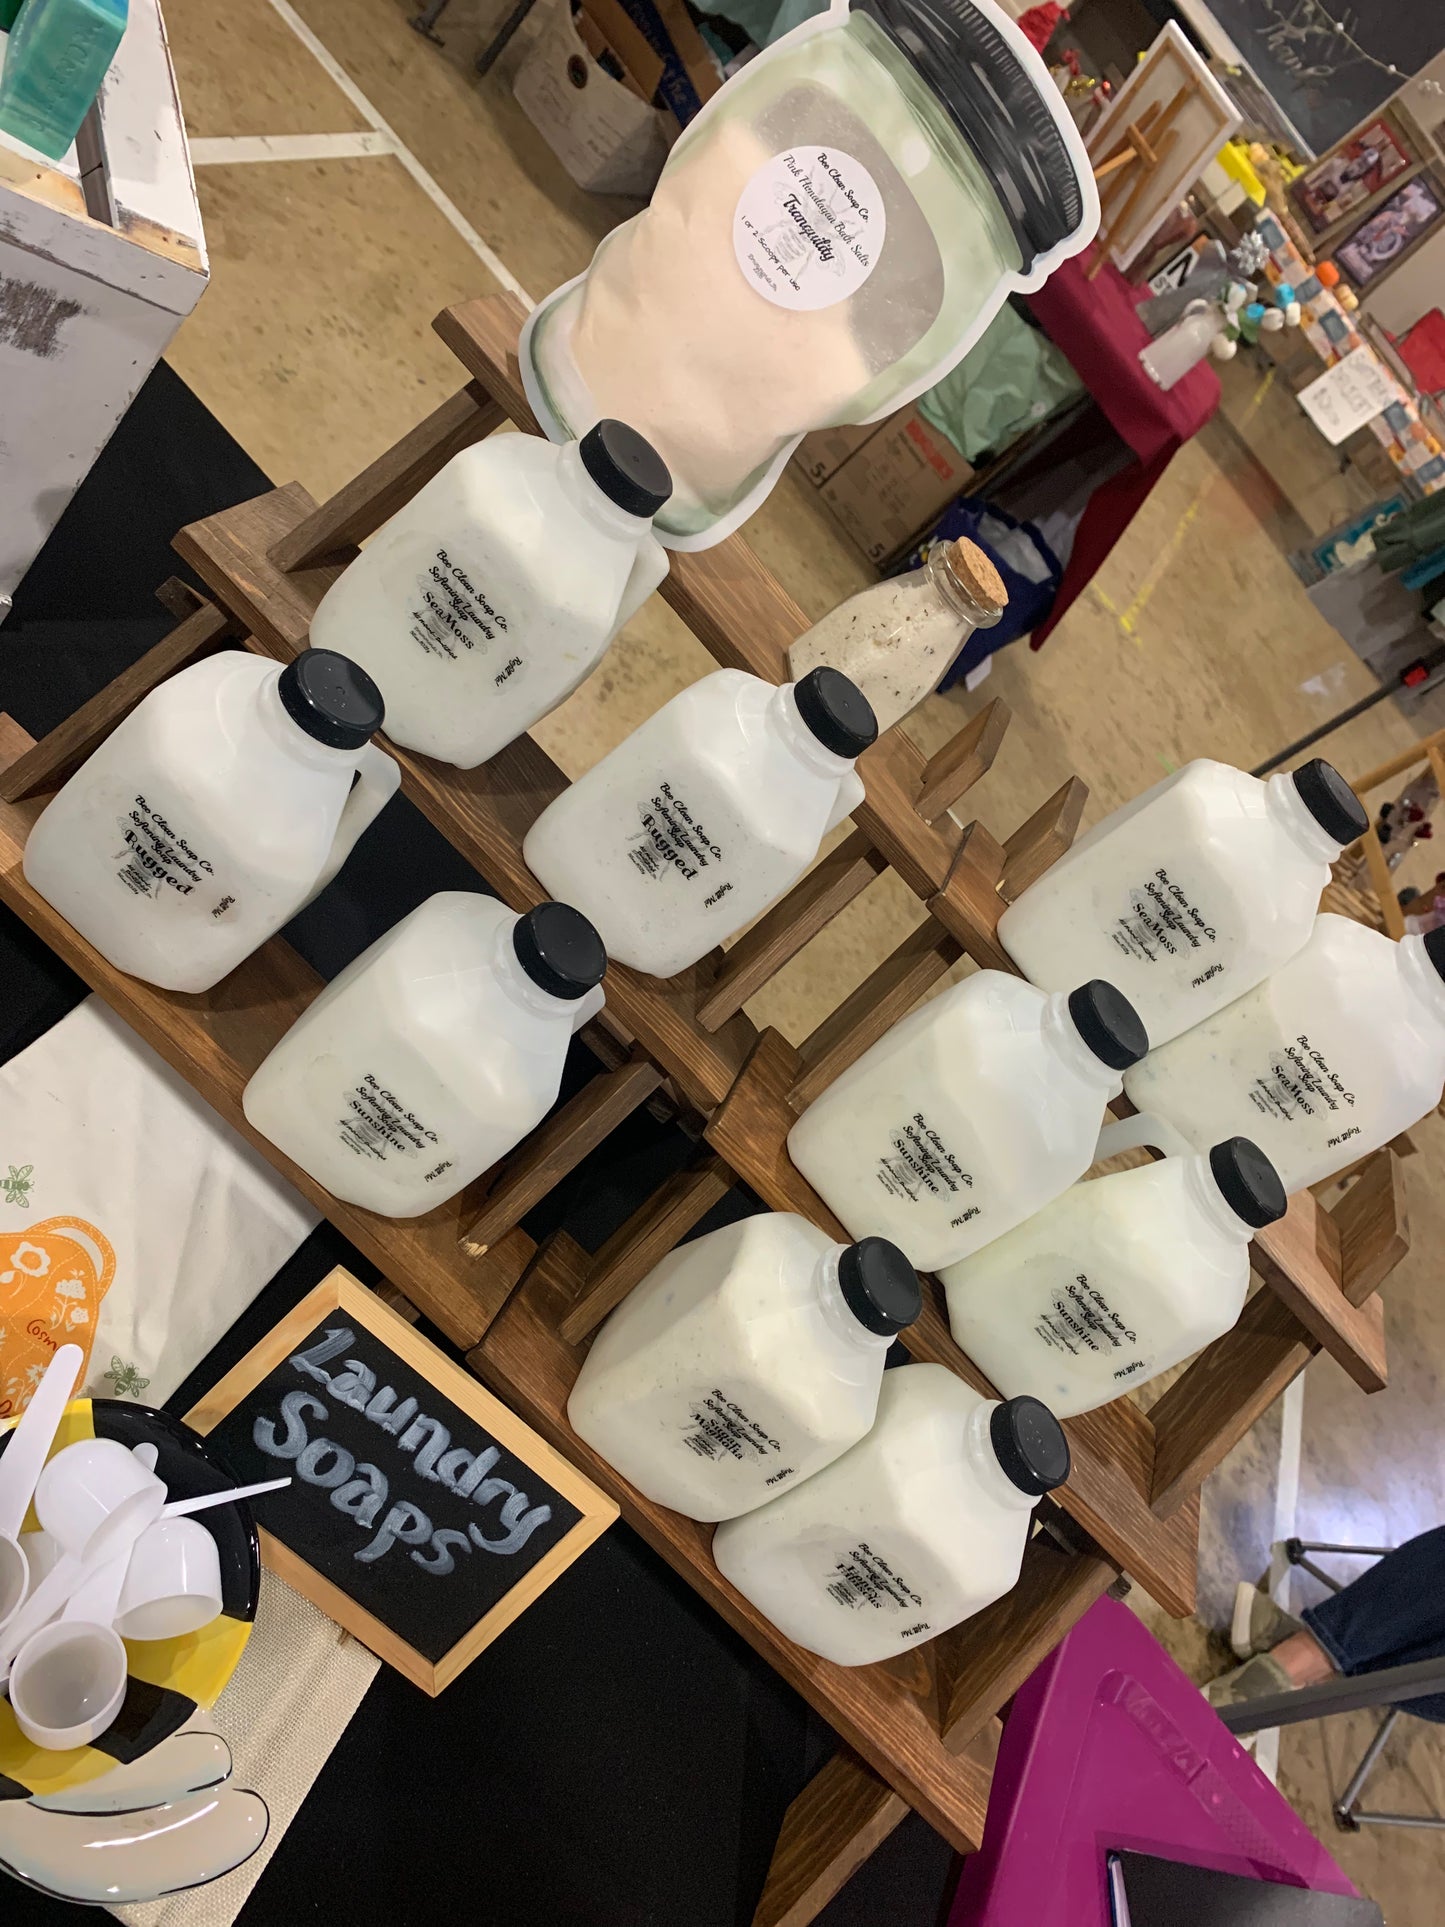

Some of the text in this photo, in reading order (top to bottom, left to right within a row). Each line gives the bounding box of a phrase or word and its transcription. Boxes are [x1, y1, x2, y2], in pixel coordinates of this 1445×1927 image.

[783, 154, 869, 266] Pink Himalayan Bath Salts
[817, 152, 869, 222] Bee Clean Soap Co.
[783, 193, 834, 261] Tranquility
[744, 220, 754, 229] or
[757, 237, 780, 264] Scoops
[776, 264, 790, 276] per
[789, 278, 800, 291] use
[810, 461, 826, 479] 5
[868, 542, 886, 559] 5
[428, 566, 495, 640] Softening Laundry
[436, 549, 507, 633] Bee Clean Soap Co.
[448, 599, 468, 621] Soap
[423, 592, 474, 649] SeaMoss
[504, 656, 523, 676] Refill
[129, 810, 166, 851] Softening
[163, 846, 202, 882] Laundry
[135, 794, 214, 876] Bee Clean Soap Co.
[642, 814, 698, 880] Rugged
[651, 797, 708, 866] Softening Laundry
[660, 782, 721, 862] Bee Clean Soap Co.
[667, 828, 685, 848] Soap
[125, 829, 193, 895] Rugged
[150, 844, 172, 864] Soap
[714, 882, 733, 900] Refill
[1144, 882, 1201, 947] Softening Laundry
[1155, 868, 1216, 943] Bee Clean Soap Co.
[1133, 903, 1177, 954] SeaMoss
[1159, 911, 1177, 930] Soap
[1204, 963, 1224, 980] Refill
[1271, 1065, 1314, 1115] SeaMoss
[1284, 1047, 1339, 1110] Softening Laundry
[1296, 1035, 1355, 1107] Bee Clean Soap Co.
[1298, 1074, 1315, 1092] Soap
[349, 1100, 405, 1150] Sunshine
[355, 1086, 392, 1123] Softening
[390, 1118, 425, 1149] Laundry
[364, 1074, 380, 1090] Bee
[380, 1090, 403, 1112] Clean
[403, 1113, 424, 1131] Soap
[377, 1114, 397, 1134] Soap
[903, 1125, 959, 1191] Softening Laundry
[913, 1113, 973, 1188] Bee Clean Soap Co.
[1341, 1126, 1361, 1141] Refill
[893, 1139, 939, 1192] Sunshine
[918, 1154, 935, 1175] Soap
[962, 1207, 981, 1221] Refill
[1053, 1301, 1099, 1350] Sunshine
[1065, 1285, 1121, 1347] Softening Laundry
[1076, 1274, 1090, 1290] Bee
[1088, 1291, 1109, 1312] Clean
[1107, 1312, 1126, 1330] Soap
[1080, 1313, 1098, 1330] Soap
[1124, 1360, 1145, 1374] Refill
[289, 1326, 553, 1556] Laundry
[703, 1399, 737, 1431] Softening
[734, 1425, 768, 1454] Laundry
[711, 1389, 727, 1403] Bee
[726, 1403, 749, 1422] Clean
[748, 1423, 768, 1439] Soap
[253, 1390, 473, 1576] Soaps
[849, 1551, 880, 1583] Softening
[877, 1578, 908, 1608] Laundry
[858, 1543, 873, 1556] Bee
[872, 1556, 893, 1576] Clean
[892, 1577, 911, 1594] Soap
